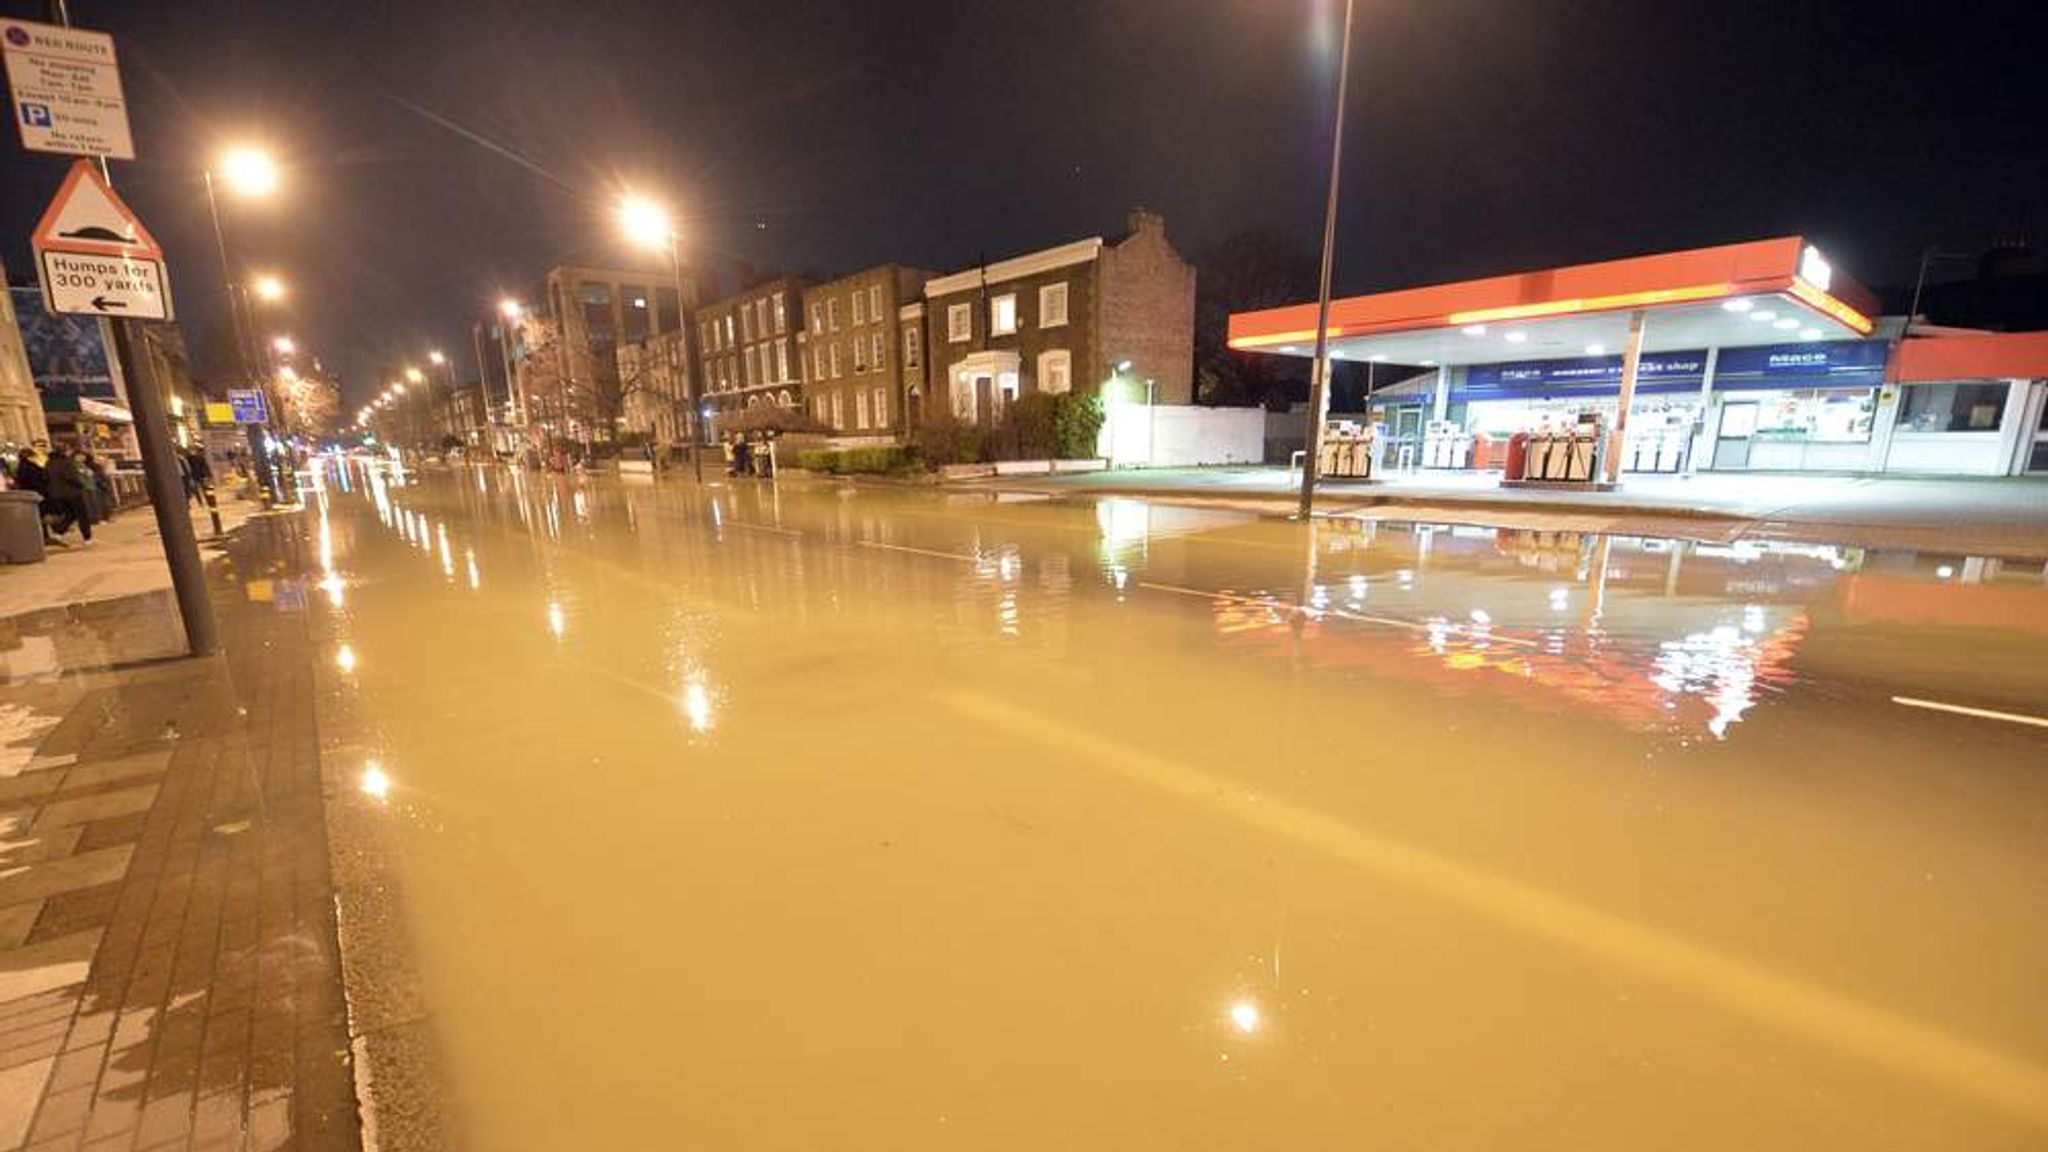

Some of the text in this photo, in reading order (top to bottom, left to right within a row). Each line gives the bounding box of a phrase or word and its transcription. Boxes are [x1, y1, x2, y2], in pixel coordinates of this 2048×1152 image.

[65, 40, 108, 54] ROUTE
[54, 258, 150, 278] Humps for
[56, 273, 155, 293] 300 yards
